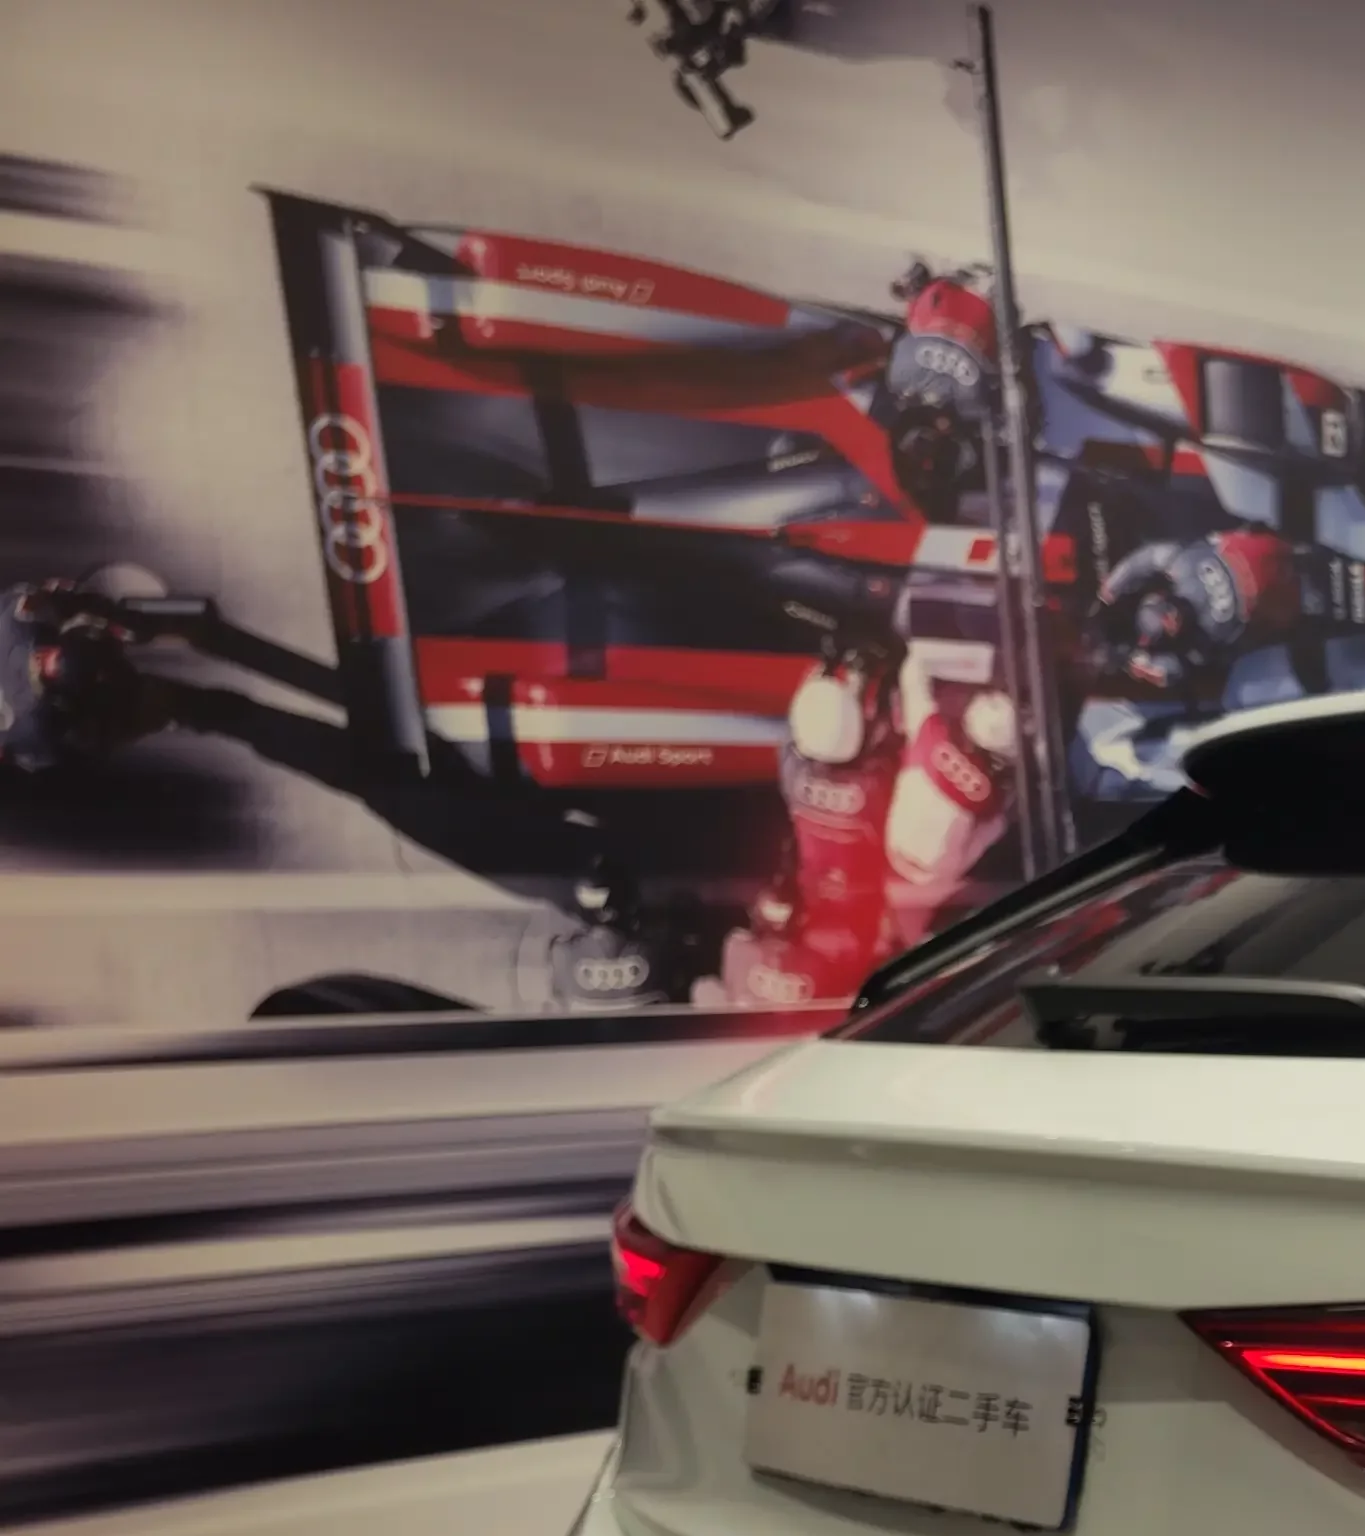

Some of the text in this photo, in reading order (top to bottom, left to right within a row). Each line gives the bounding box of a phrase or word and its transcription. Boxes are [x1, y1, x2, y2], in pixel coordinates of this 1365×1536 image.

[609, 747, 712, 767] Audi Sport
[779, 1364, 1033, 1437] Audi 官方认证二手车
